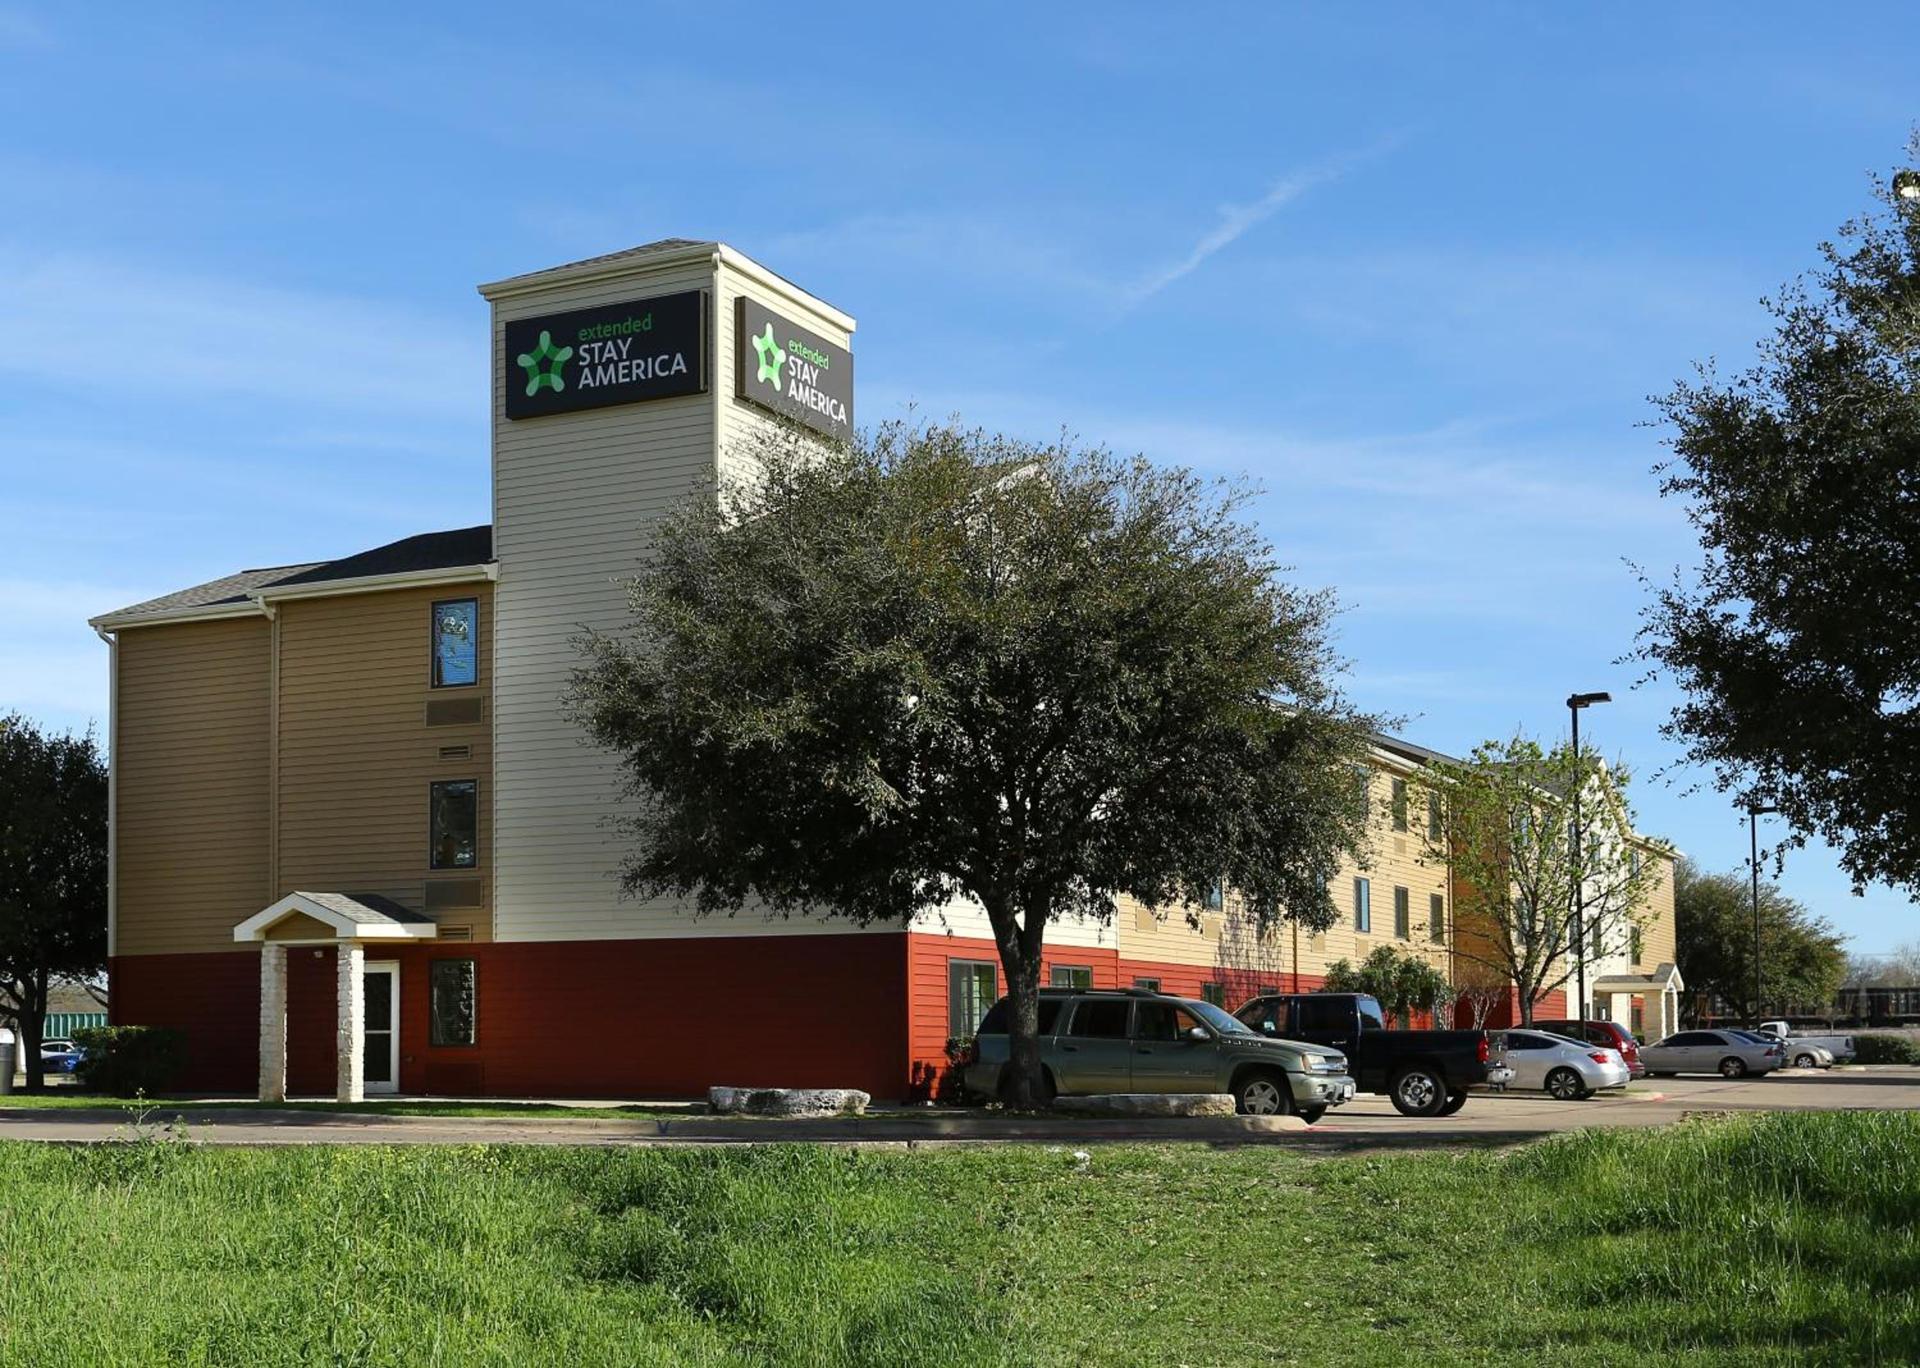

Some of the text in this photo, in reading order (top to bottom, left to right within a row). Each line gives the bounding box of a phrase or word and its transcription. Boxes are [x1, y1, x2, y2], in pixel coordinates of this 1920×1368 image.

[578, 312, 652, 341] extended
[578, 337, 632, 366] STAY
[788, 339, 829, 370] extended
[578, 352, 687, 390] AMERICA
[788, 355, 819, 387] STAY
[788, 378, 847, 425] AMERICA
